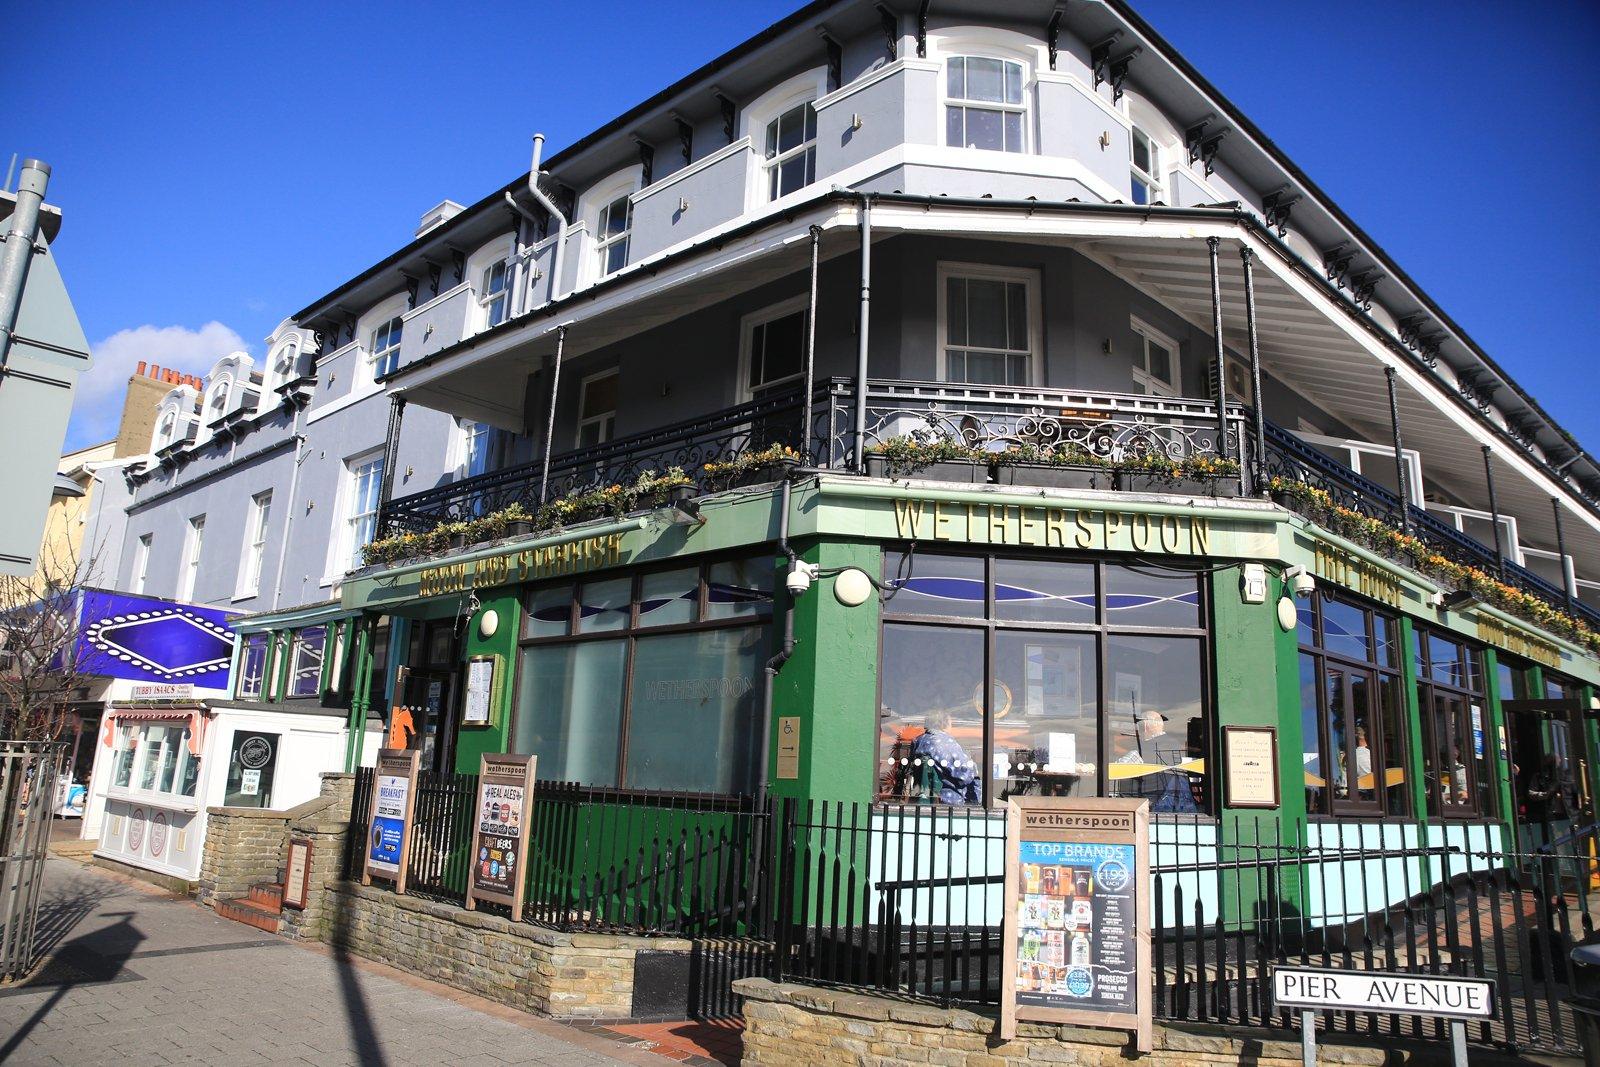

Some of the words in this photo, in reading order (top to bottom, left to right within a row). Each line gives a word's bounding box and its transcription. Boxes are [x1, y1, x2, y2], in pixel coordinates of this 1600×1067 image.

[893, 499, 1212, 556] WETHERSPOON
[420, 563, 466, 596] MOON
[473, 554, 511, 588] AND
[517, 533, 622, 582] STARFISH
[645, 673, 755, 705] WETHERSPOON
[487, 765, 526, 775] wetherspoon
[380, 787, 405, 800] BREAKFAST
[491, 787, 503, 799] REAL
[503, 789, 517, 801] ALES
[1026, 814, 1130, 828] wetherspoon
[497, 838, 513, 850] BEERS
[1032, 844, 1061, 856] TOP
[1065, 846, 1124, 860] BRANDS
[1099, 869, 1127, 881] £1.99
[1098, 974, 1128, 984] PROSECCO
[1284, 975, 1341, 1000] PIER
[1367, 980, 1481, 1010] AVENUE
